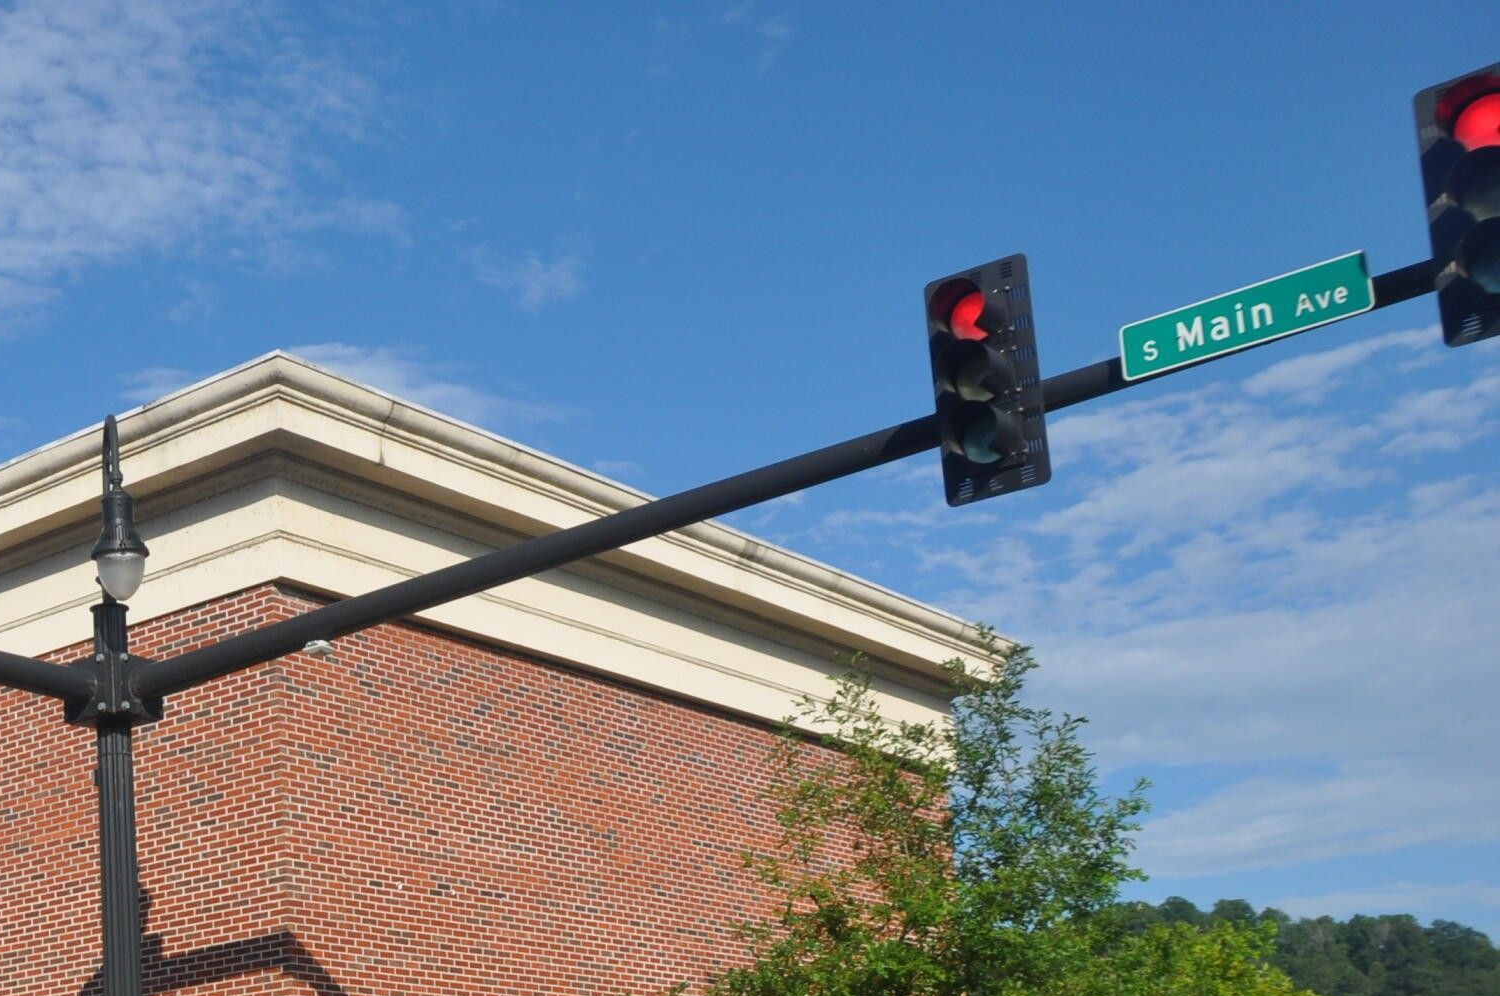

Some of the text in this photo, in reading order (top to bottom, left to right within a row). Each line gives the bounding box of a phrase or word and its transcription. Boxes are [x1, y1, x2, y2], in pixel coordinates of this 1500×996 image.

[1142, 285, 1349, 361] S Main Ave
